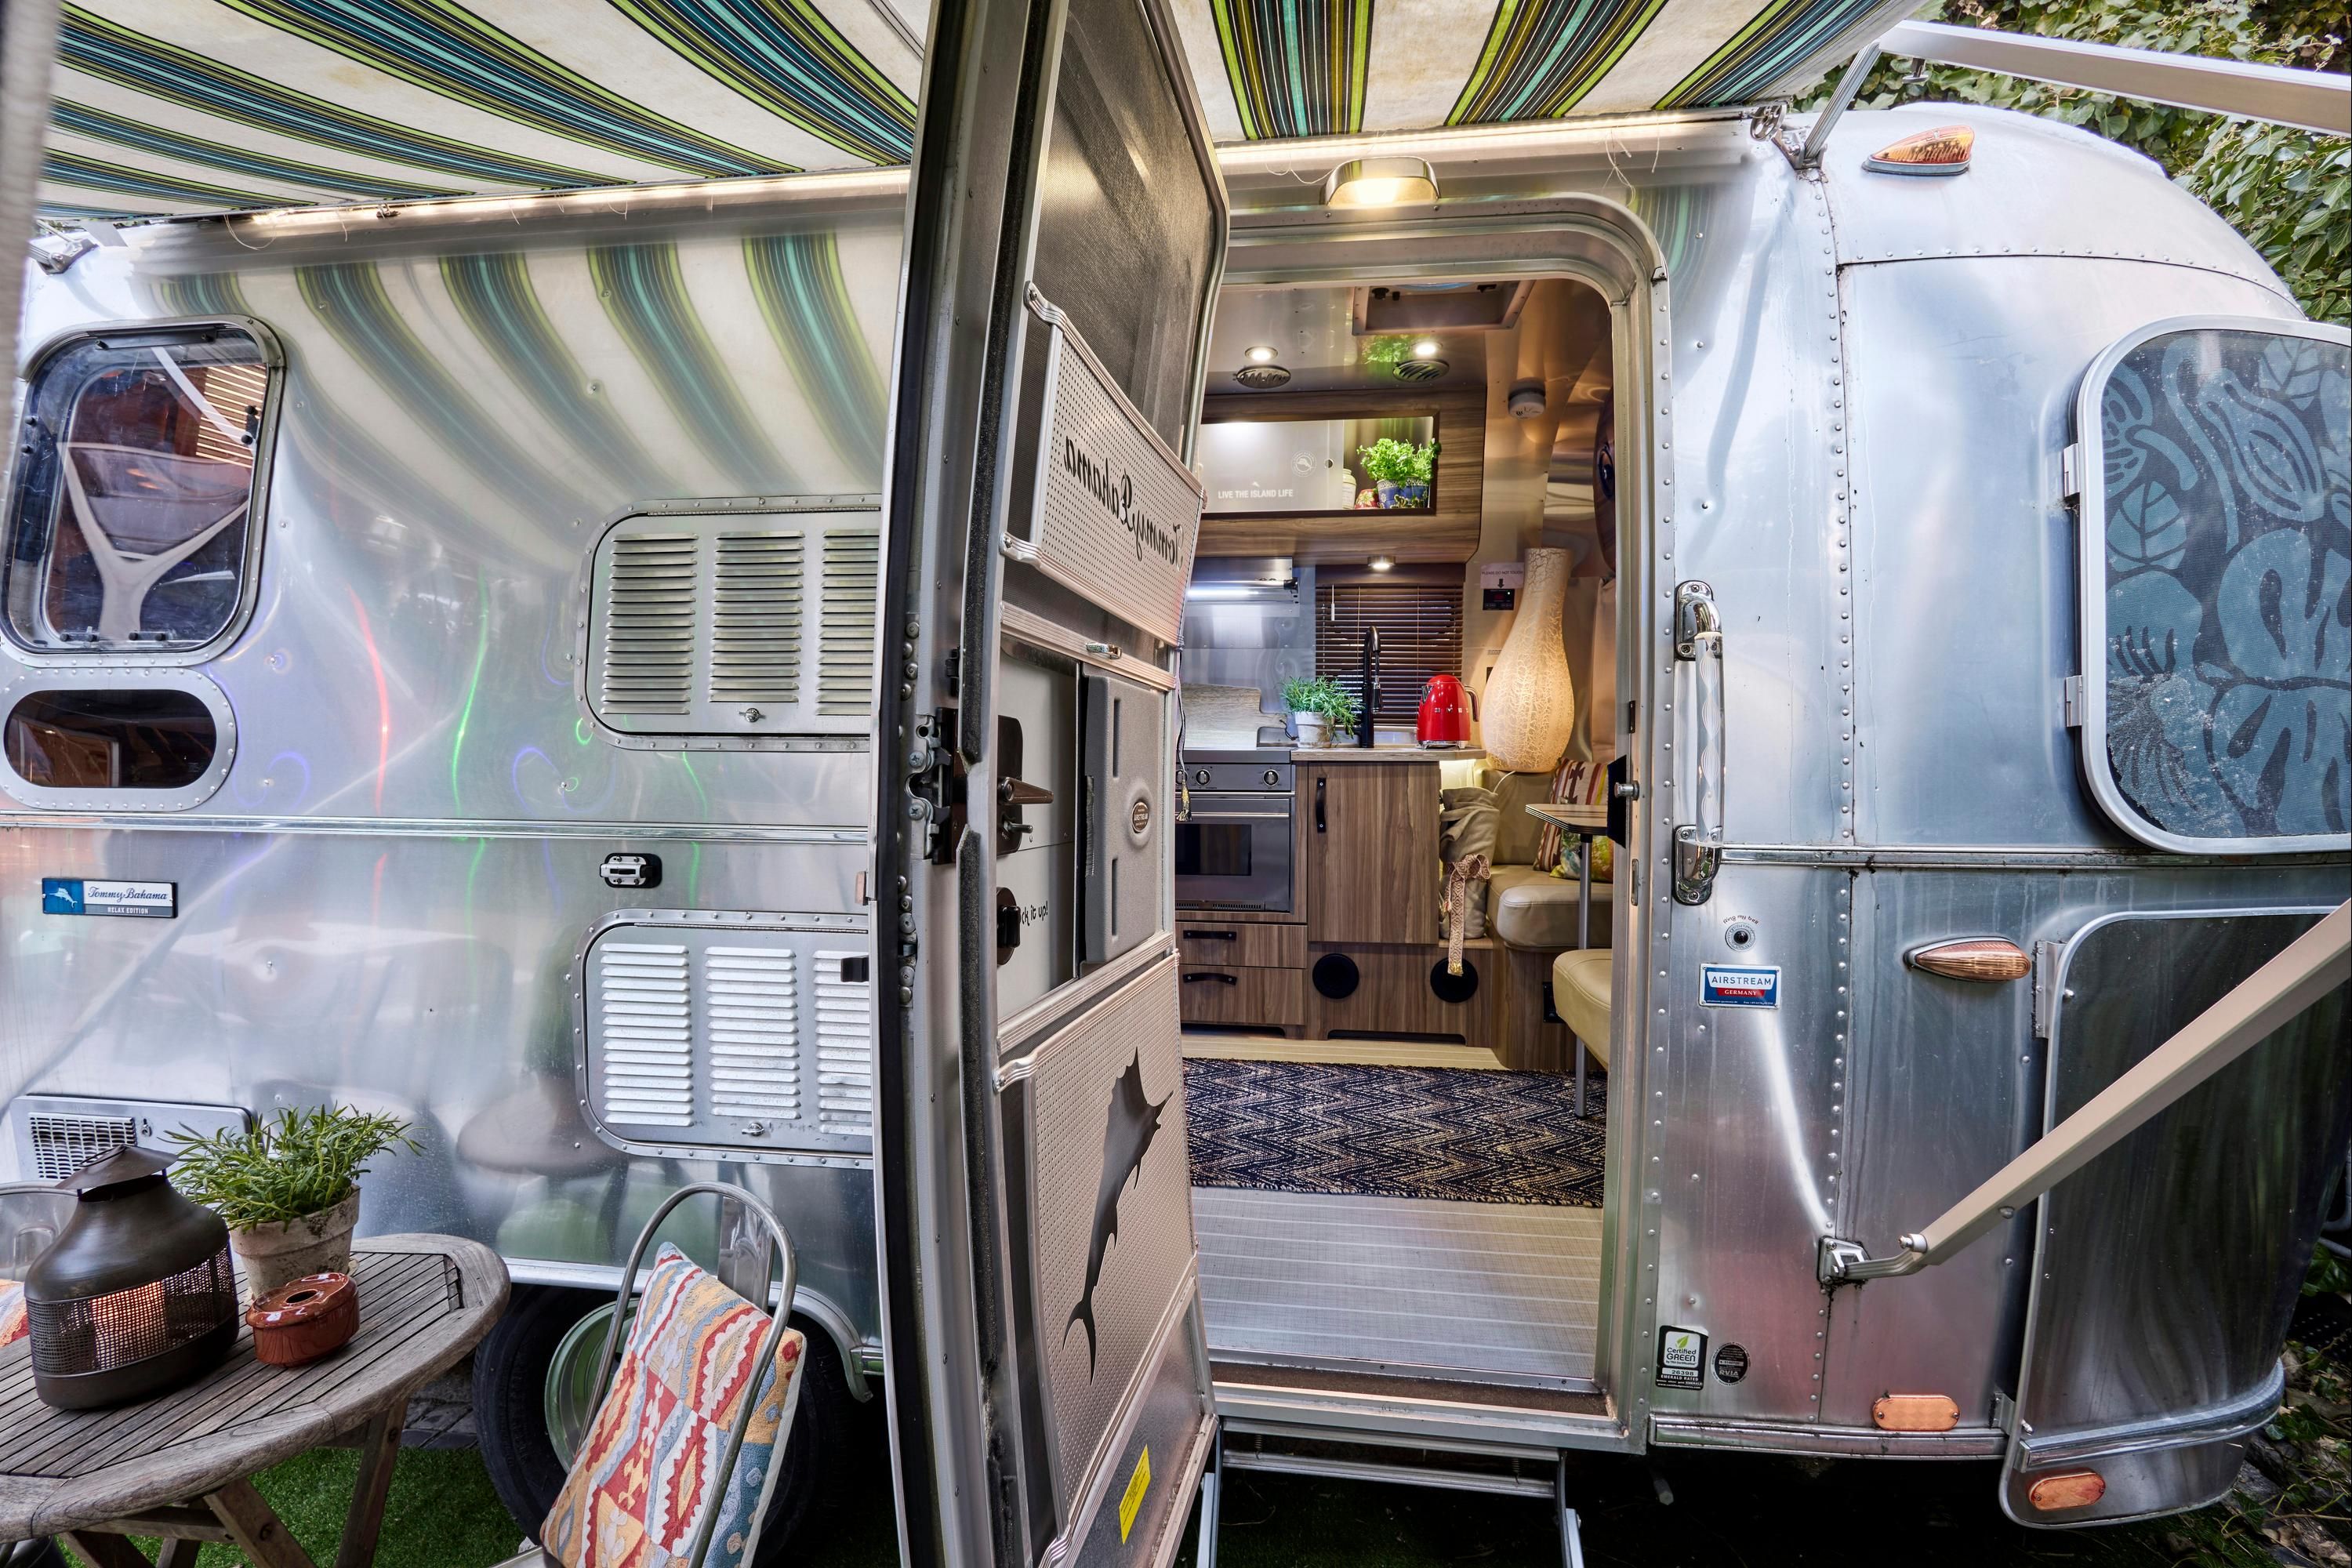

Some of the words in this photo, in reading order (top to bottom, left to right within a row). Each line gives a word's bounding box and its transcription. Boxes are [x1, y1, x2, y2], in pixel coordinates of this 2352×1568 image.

[1218, 490, 1233, 499] LIVE
[1235, 490, 1249, 499] THE
[1250, 489, 1276, 498] ISLAND
[88, 886, 124, 902] Tommy
[122, 887, 168, 900] Bahama
[1030, 905, 1036, 920] it
[1038, 901, 1047, 921] up!
[1711, 976, 1771, 985] AIRSTREAM
